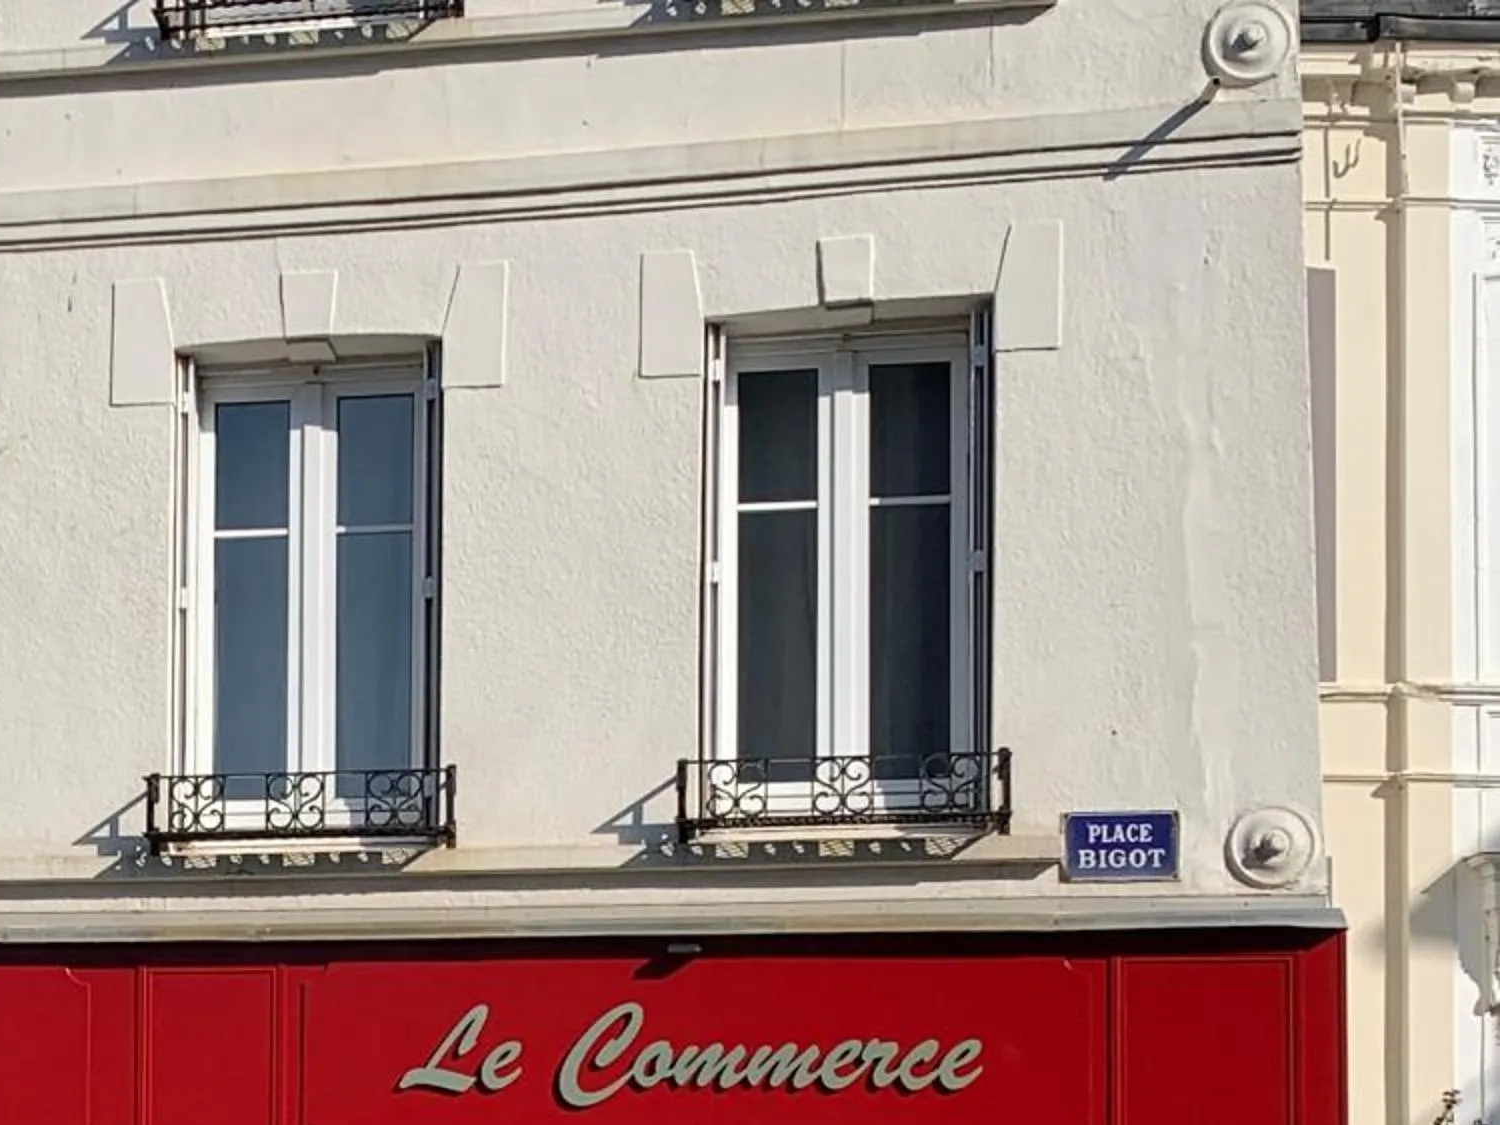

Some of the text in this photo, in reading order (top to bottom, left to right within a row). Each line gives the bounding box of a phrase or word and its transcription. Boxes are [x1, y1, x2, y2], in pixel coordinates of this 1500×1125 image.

[1088, 823, 1153, 843] PLACE
[1078, 849, 1166, 868] BIGOT
[399, 1001, 984, 1108] Le Commerce
